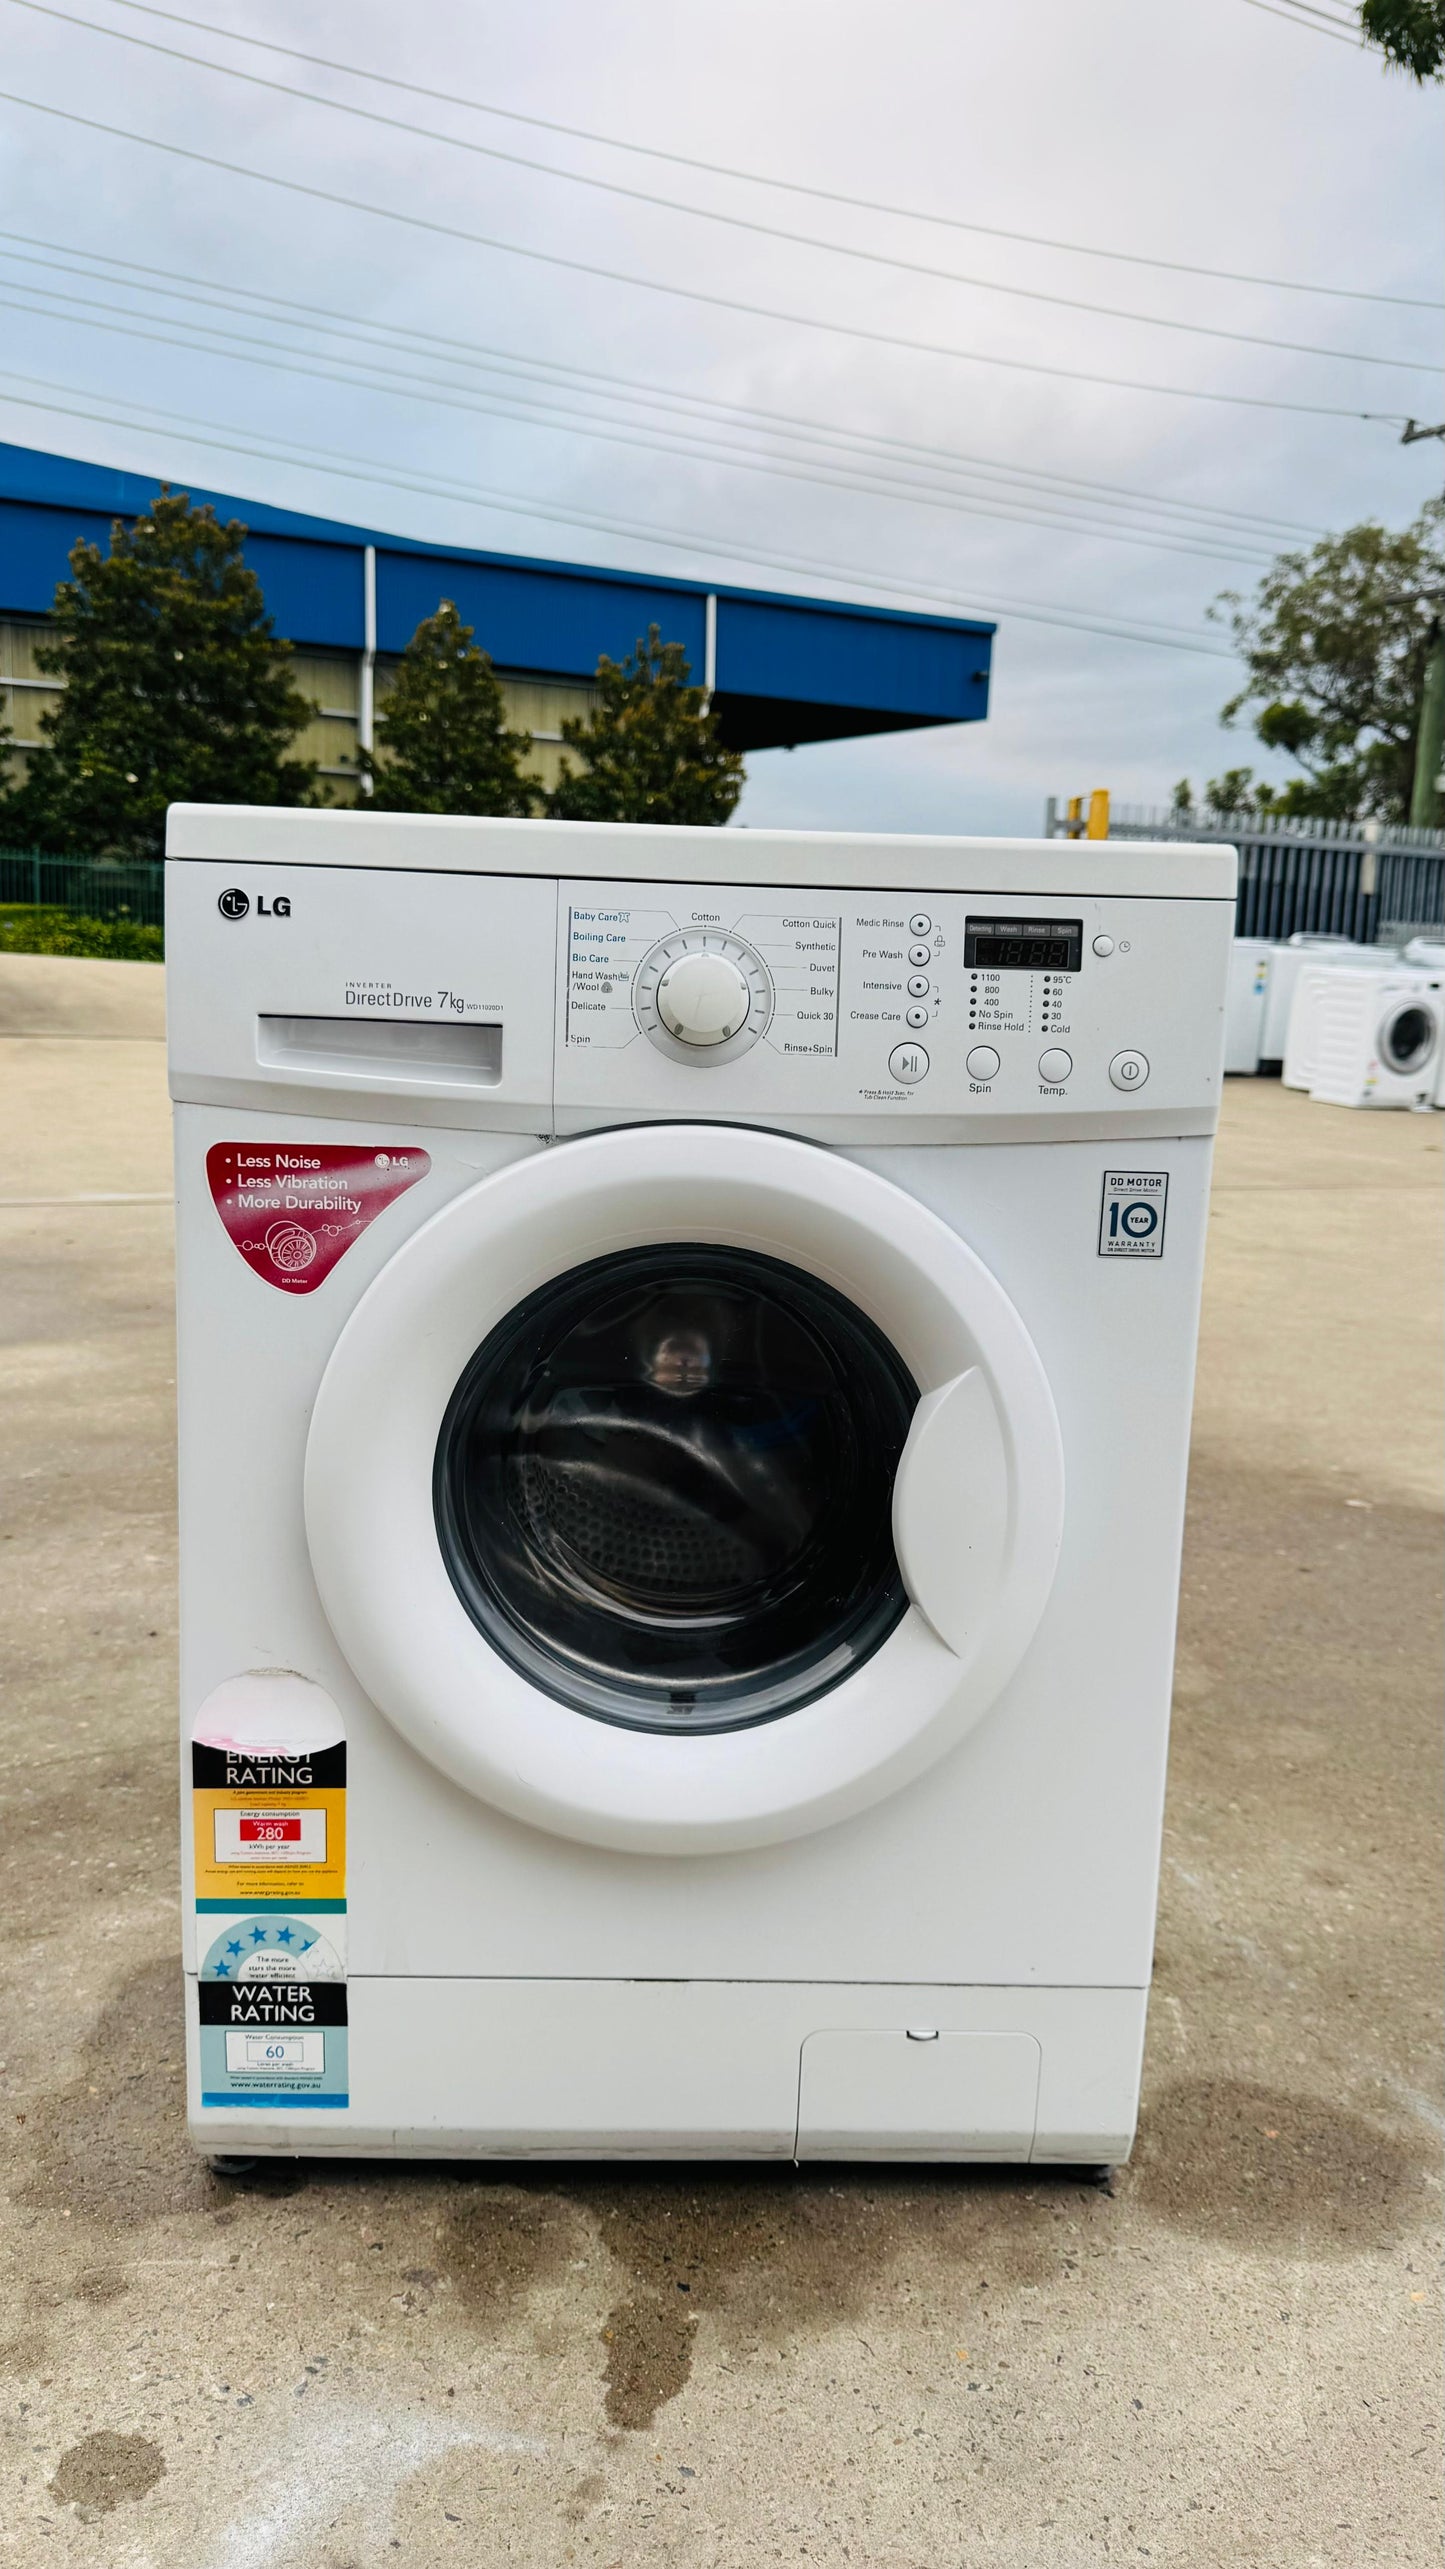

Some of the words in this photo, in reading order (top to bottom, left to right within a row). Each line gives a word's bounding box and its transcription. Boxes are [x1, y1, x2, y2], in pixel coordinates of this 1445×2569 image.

[257, 895, 291, 917] LG
[573, 911, 596, 922] Baby
[598, 912, 618, 921] Care
[691, 912, 720, 922] Cotton
[782, 919, 810, 928] Cotton
[812, 919, 836, 929] Quick
[856, 918, 881, 927] Medic
[882, 918, 904, 928] Rinse
[969, 925, 992, 934] Detecting
[1057, 927, 1072, 935] Spin
[573, 932, 604, 943] Boiling
[606, 933, 626, 942] Care
[795, 941, 836, 951] Synthetic
[572, 953, 587, 962] Bio
[588, 954, 609, 963] Care
[862, 949, 877, 958] Pre
[879, 950, 903, 959] Wash
[809, 963, 835, 972] Duvet
[572, 971, 593, 980] Hand
[595, 972, 617, 981] Wash
[981, 973, 1000, 982] 1100
[572, 982, 599, 991] /Wool
[863, 981, 902, 990] Intensive
[984, 986, 1000, 994] 800
[810, 987, 834, 997] Bulky
[1052, 988, 1063, 996] 60
[571, 1001, 606, 1011] Delicate
[983, 998, 999, 1006] 400
[1052, 1000, 1062, 1008] 40
[796, 1011, 821, 1020] Quick
[823, 1012, 834, 1020] 30
[850, 1011, 879, 1020] Crease
[881, 1012, 901, 1021] Care
[978, 1010, 991, 1019] No
[993, 1010, 1013, 1020] Spin
[1051, 1012, 1062, 1020] 30
[978, 1022, 1002, 1031] Rinse
[1004, 1023, 1025, 1032] Hold
[1050, 1024, 1070, 1034] Cold
[570, 1034, 591, 1044] Spin
[784, 1043, 833, 1054] Rinse+Spin
[969, 1083, 992, 1094] Spin
[1038, 1085, 1068, 1097] Temp.
[237, 1153, 271, 1168] Less
[275, 1154, 321, 1169] Noise
[392, 1156, 409, 1167] LG
[237, 1174, 272, 1188] Less
[276, 1174, 348, 1190] Vibration
[1110, 1177, 1124, 1186] DD
[1126, 1178, 1162, 1187] MOTOR
[238, 1194, 281, 1209] More
[285, 1196, 362, 1214] Durability
[1109, 1201, 1158, 1239] 10
[226, 1767, 313, 1785] RATING
[257, 1827, 284, 1840] 280
[232, 1985, 313, 2002] WATER
[230, 2005, 315, 2022] RATING
[265, 2045, 285, 2059] 60
